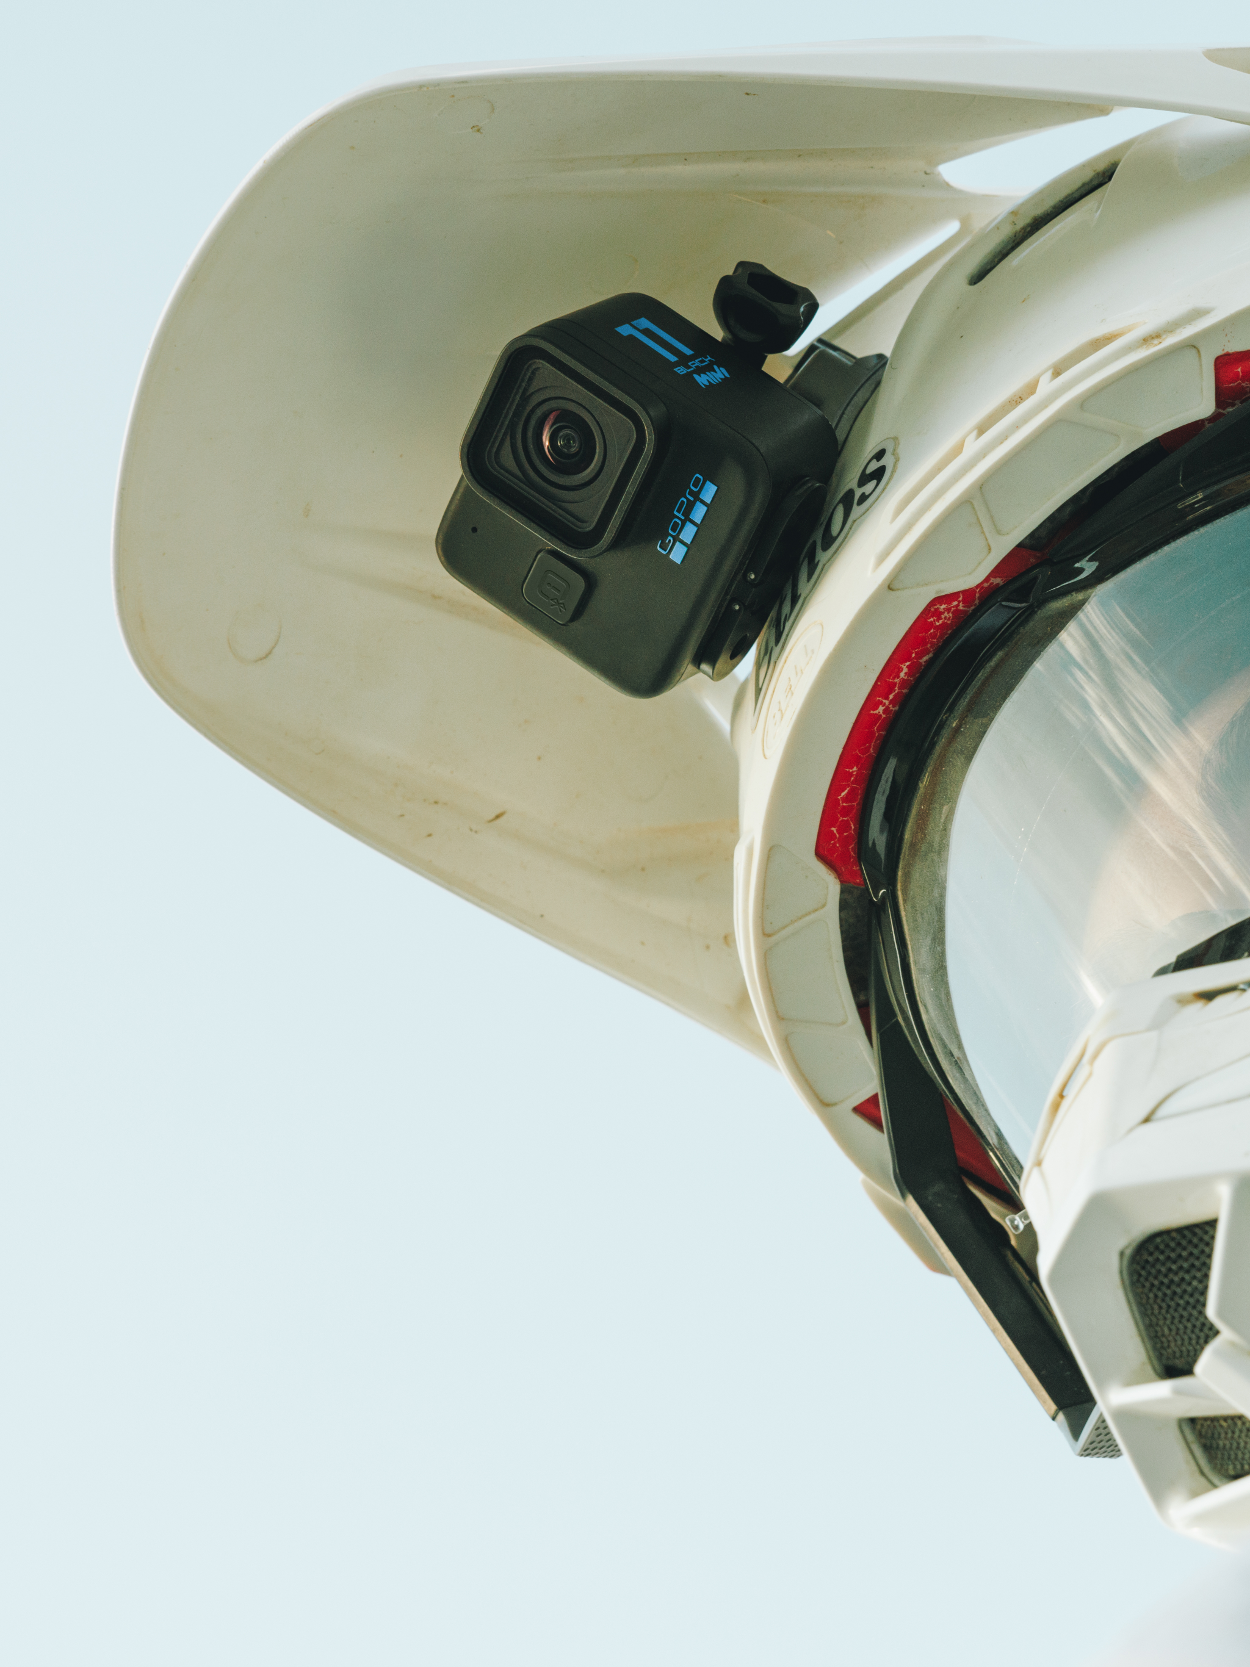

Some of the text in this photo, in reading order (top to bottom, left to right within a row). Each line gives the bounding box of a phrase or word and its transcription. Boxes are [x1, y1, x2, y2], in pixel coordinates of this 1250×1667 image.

[614, 317, 694, 362] 11
[673, 355, 715, 375] BLACK
[692, 365, 730, 388] MINI
[656, 473, 704, 555] GoPro
